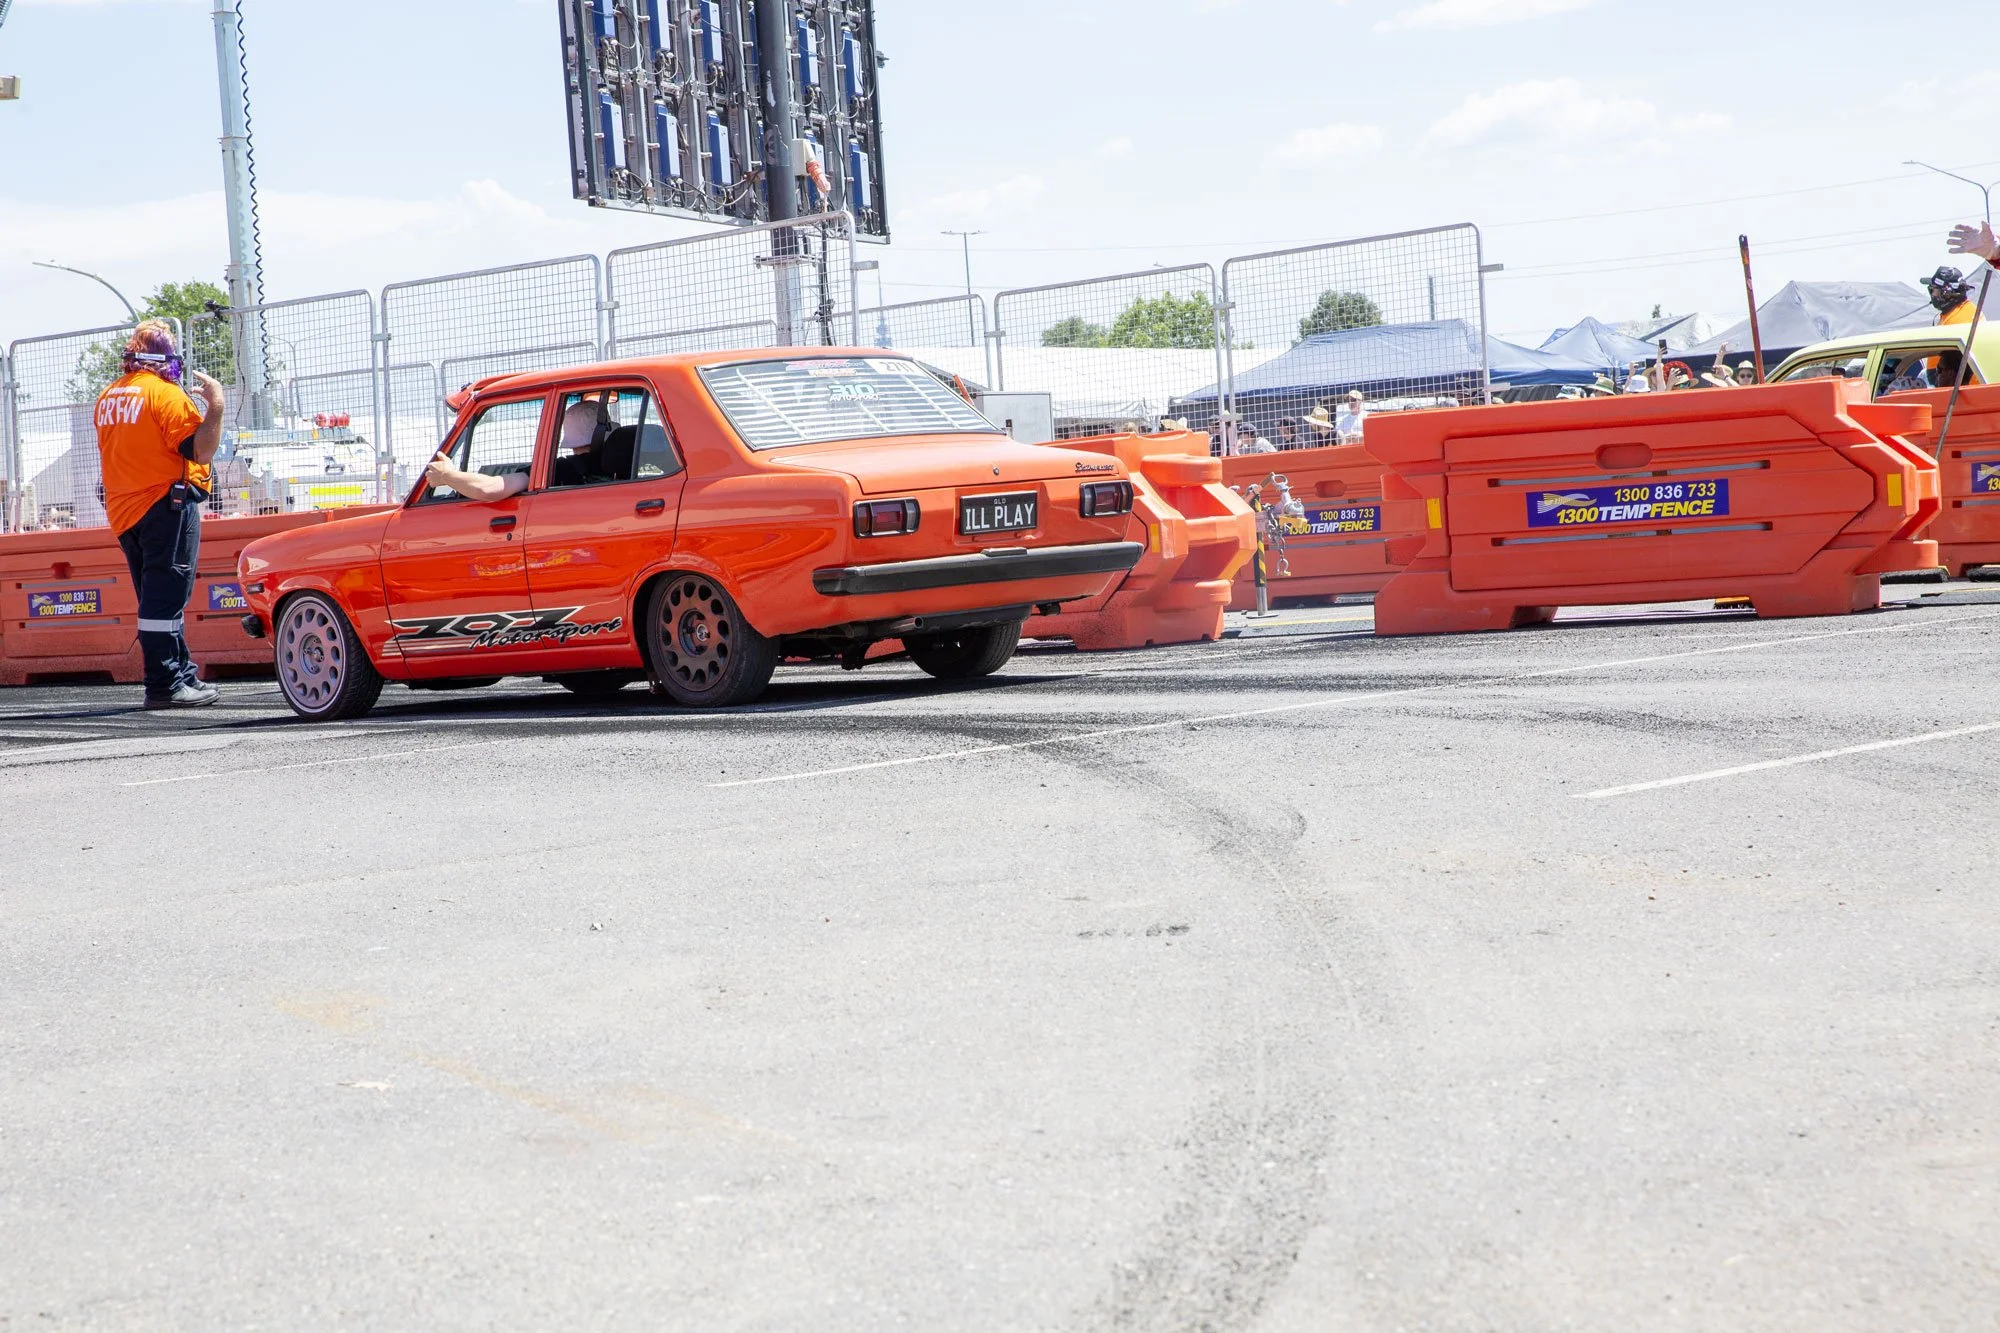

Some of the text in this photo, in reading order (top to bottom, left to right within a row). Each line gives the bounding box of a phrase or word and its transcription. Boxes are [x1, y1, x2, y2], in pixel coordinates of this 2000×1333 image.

[827, 384, 877, 398] 310
[97, 396, 145, 426] CREW
[1614, 482, 1716, 503] 1300 836 733
[965, 503, 1034, 530] ILL PLAY
[1319, 508, 1374, 521] 1300 836 733
[1556, 499, 1715, 525] 1300TEMPFENCE
[59, 591, 97, 602] 1300 836 733
[38, 603, 97, 616] 1300TEMPFENCE
[469, 616, 624, 650] Motorsport
